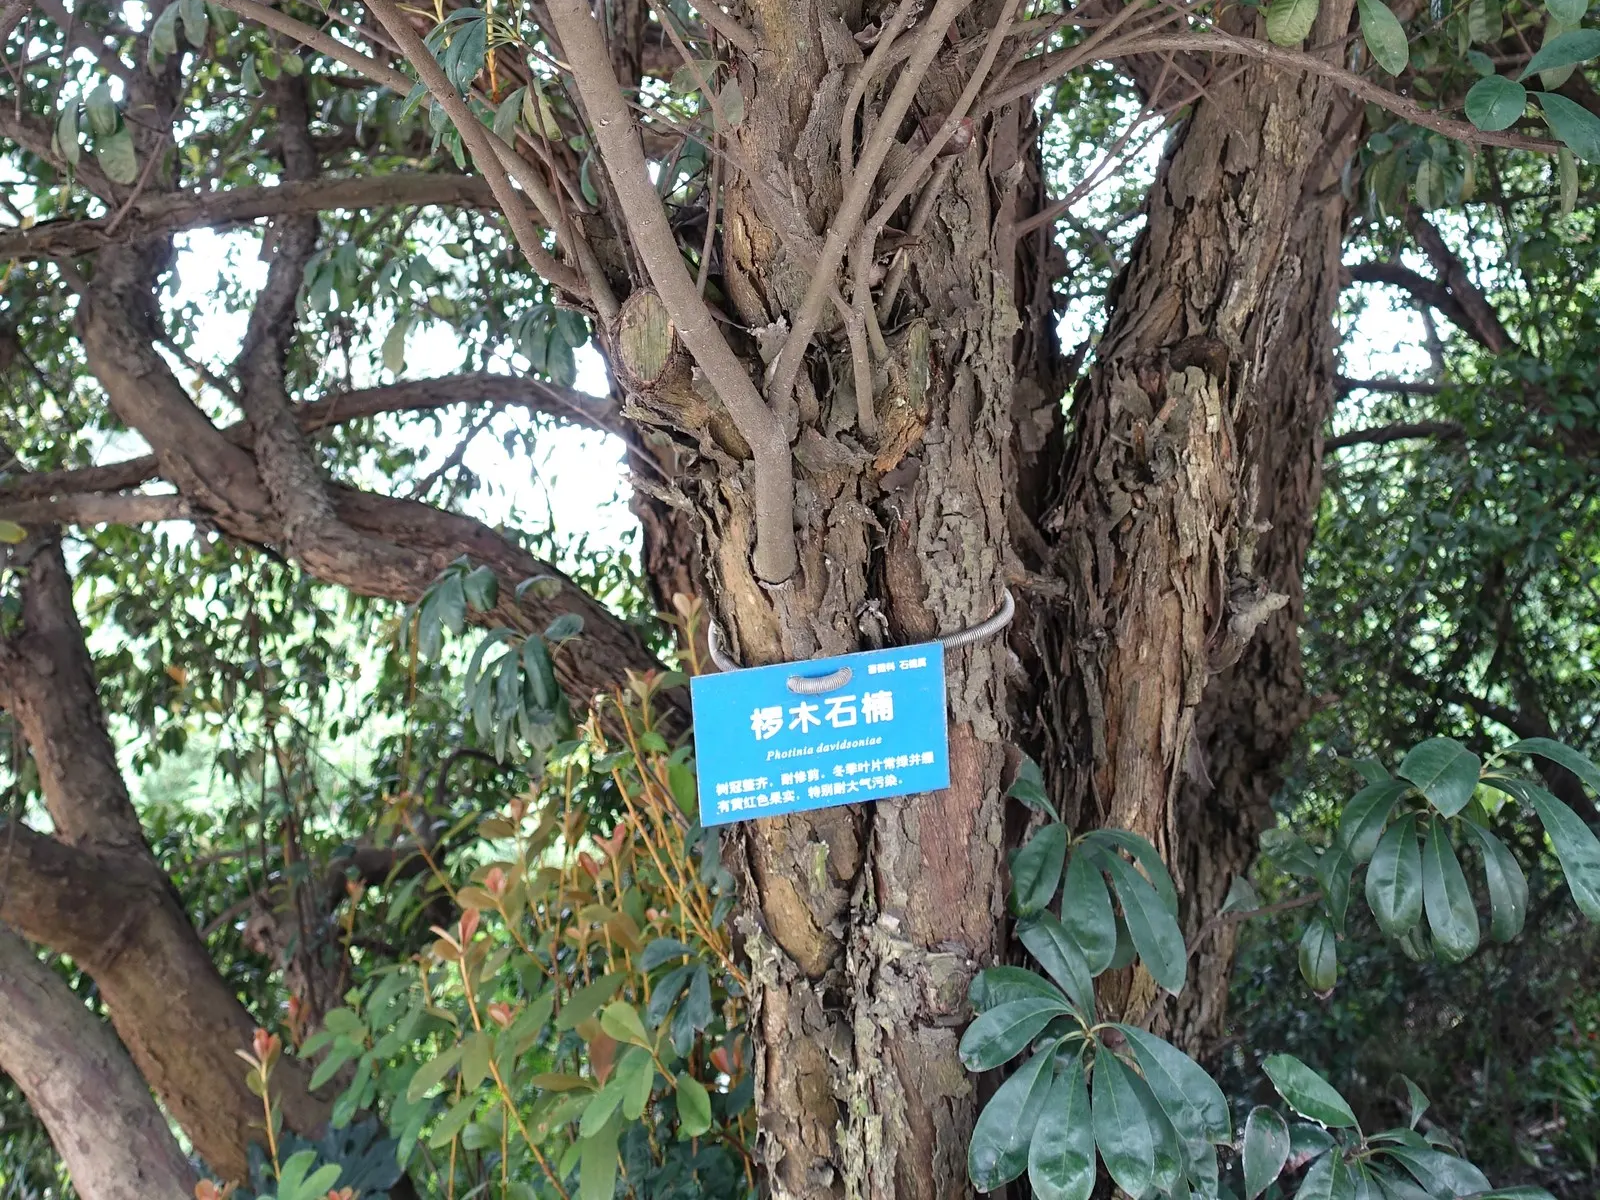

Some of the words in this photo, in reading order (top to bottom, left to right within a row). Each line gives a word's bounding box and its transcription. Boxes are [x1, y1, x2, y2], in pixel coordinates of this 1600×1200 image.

[750, 690, 893, 740] 椤木石楠
[766, 748, 814, 761] Photinia
[815, 737, 882, 754] davidsoniae
